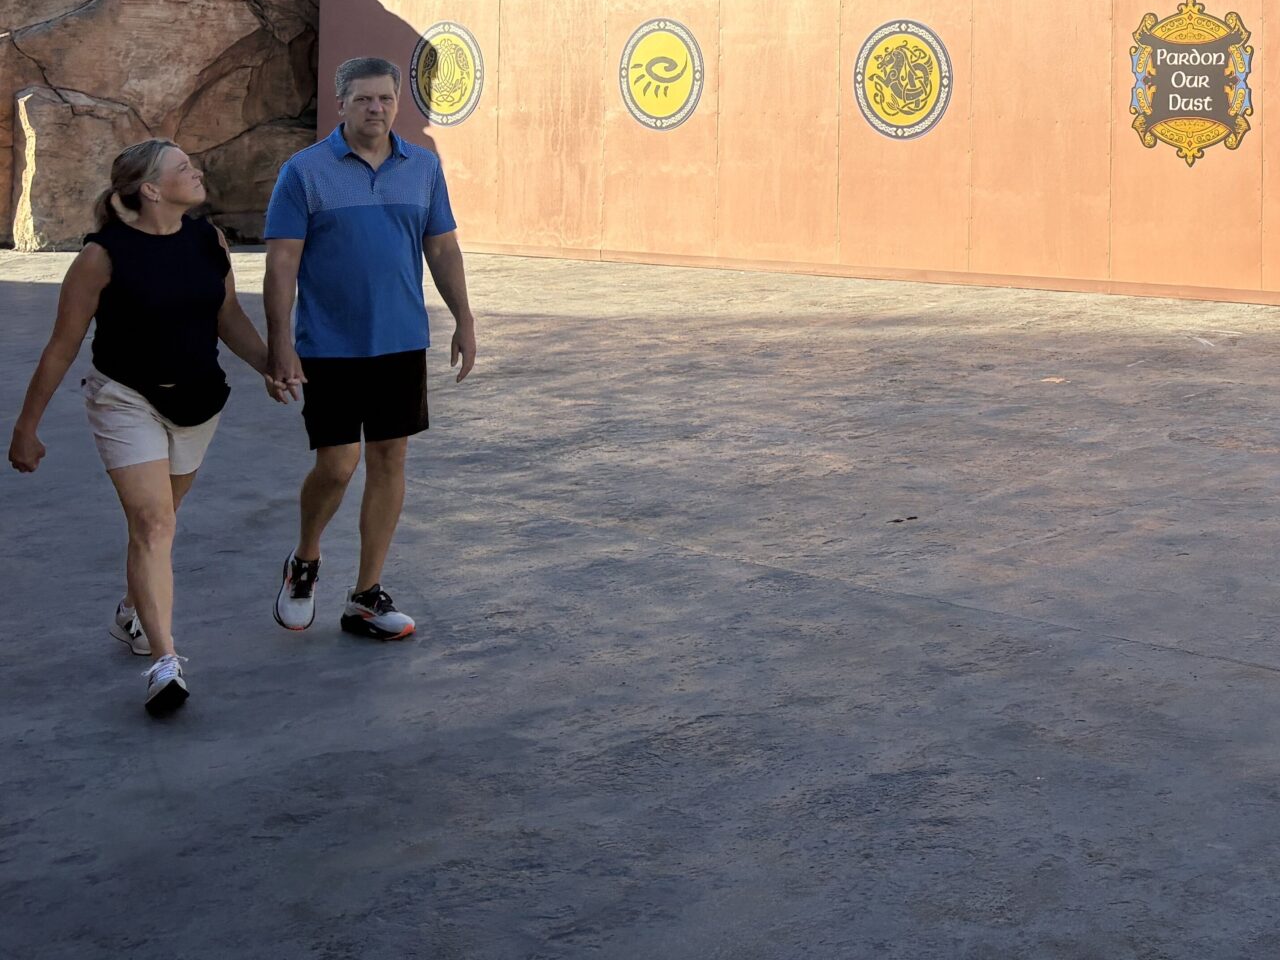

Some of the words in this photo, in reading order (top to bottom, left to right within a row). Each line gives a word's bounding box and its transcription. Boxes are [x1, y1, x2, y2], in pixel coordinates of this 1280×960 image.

[1157, 49, 1225, 65] Pardon
[1171, 71, 1210, 88] Our
[1169, 94, 1212, 111] Dust
